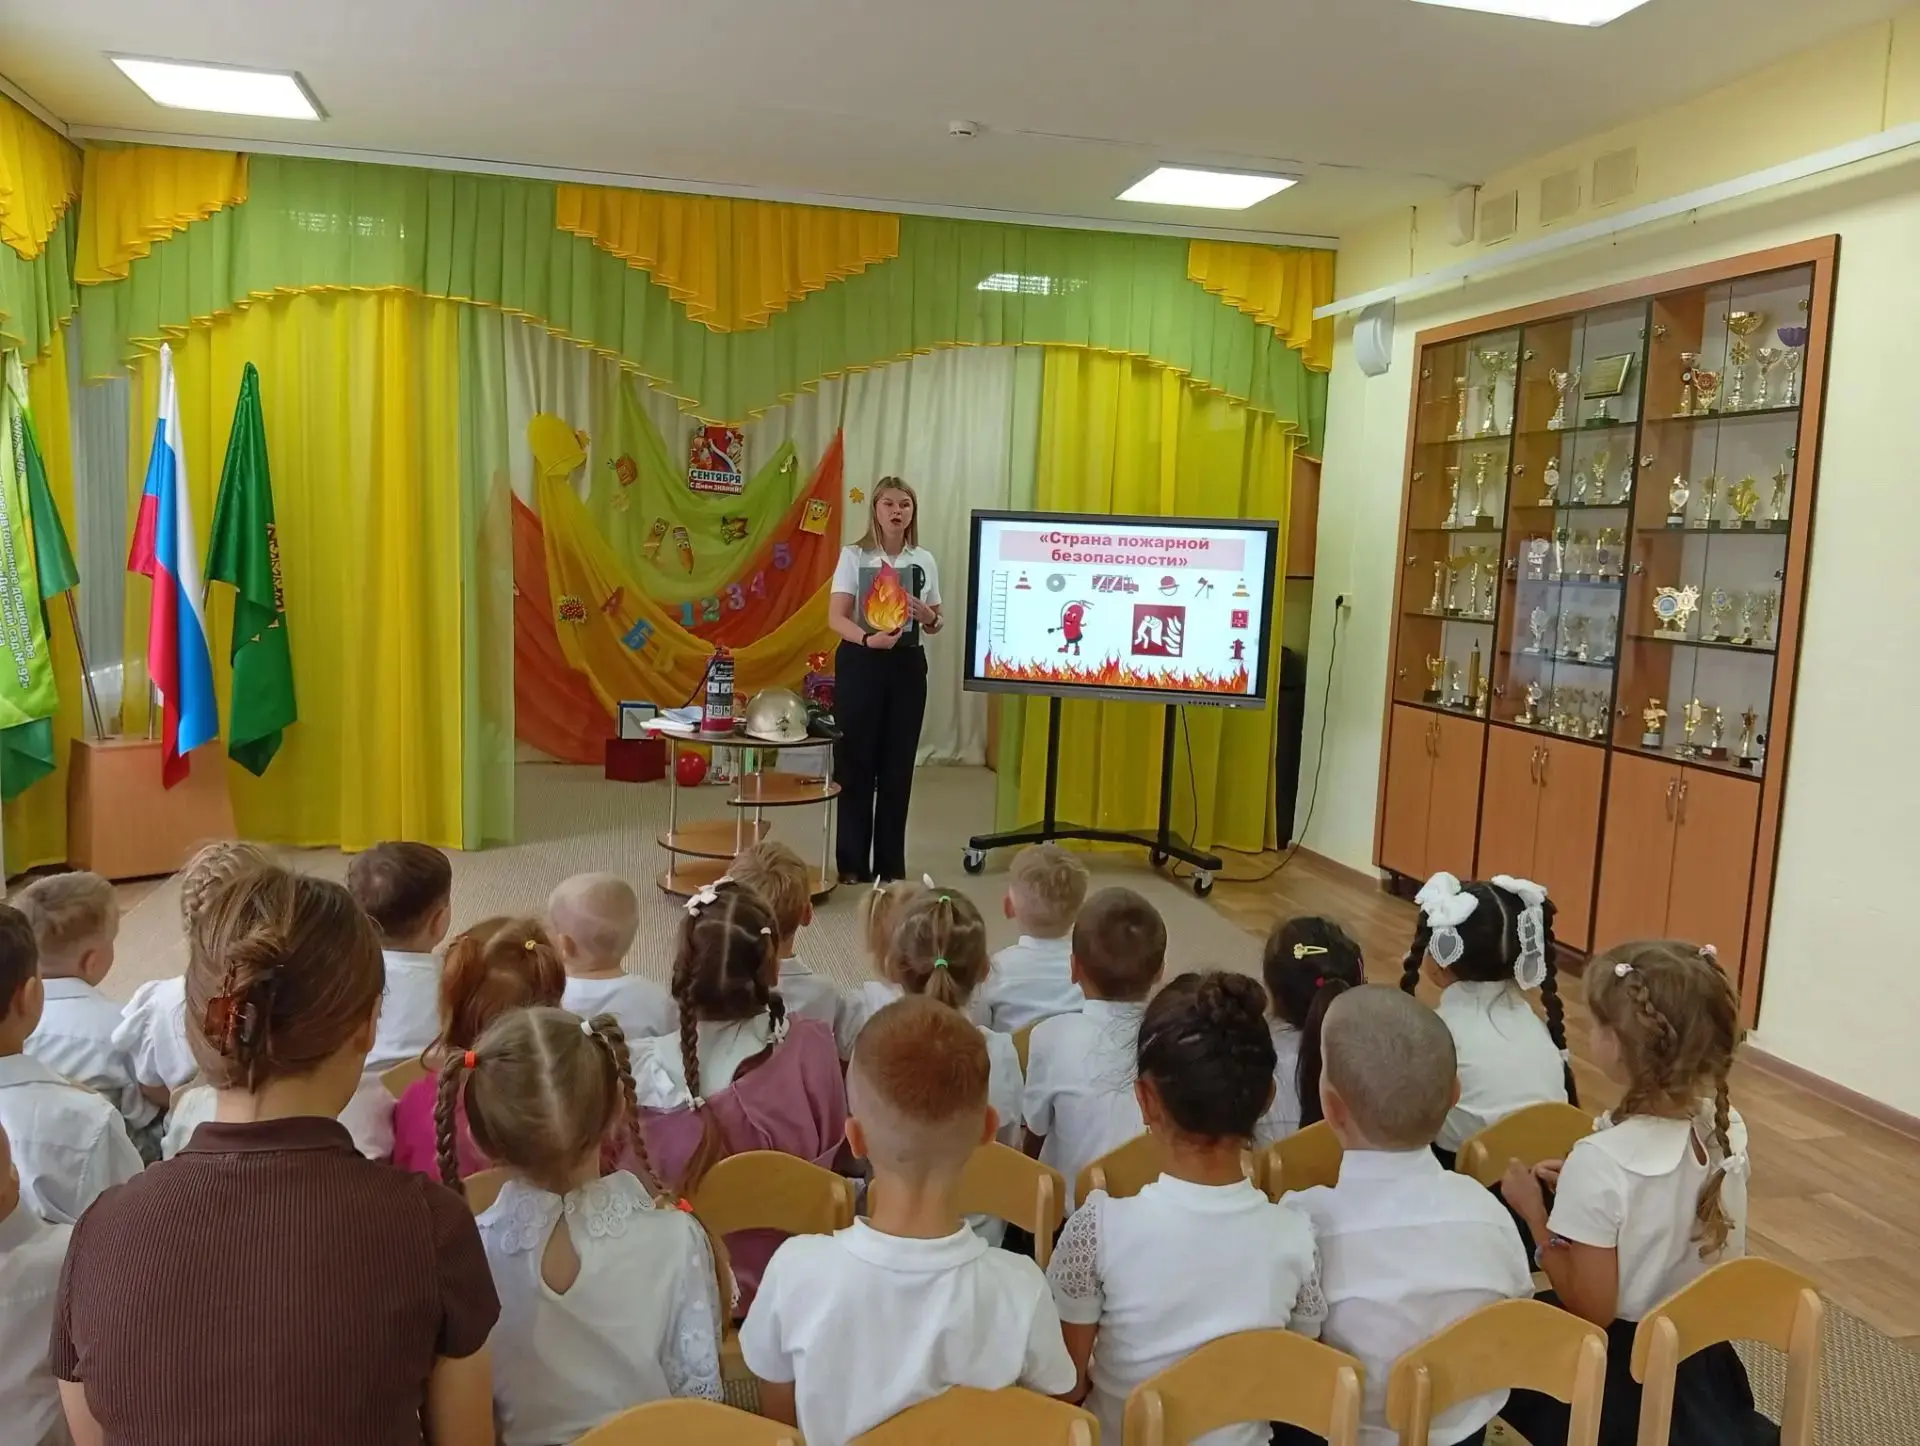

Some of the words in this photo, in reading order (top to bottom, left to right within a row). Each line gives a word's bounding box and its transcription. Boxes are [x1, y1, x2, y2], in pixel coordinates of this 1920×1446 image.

[690, 470, 742, 484] СЕНТЯБРЯ
[1039, 531, 1112, 548] «Страна
[1118, 535, 1210, 551] пожарной
[1051, 549, 1188, 566] безопасности»
[700, 597, 720, 622] 2
[727, 583, 745, 610] 3
[772, 541, 792, 570] 5
[12, 586, 35, 659] дошкольное
[8, 628, 20, 651] сад
[15, 651, 26, 666] №
